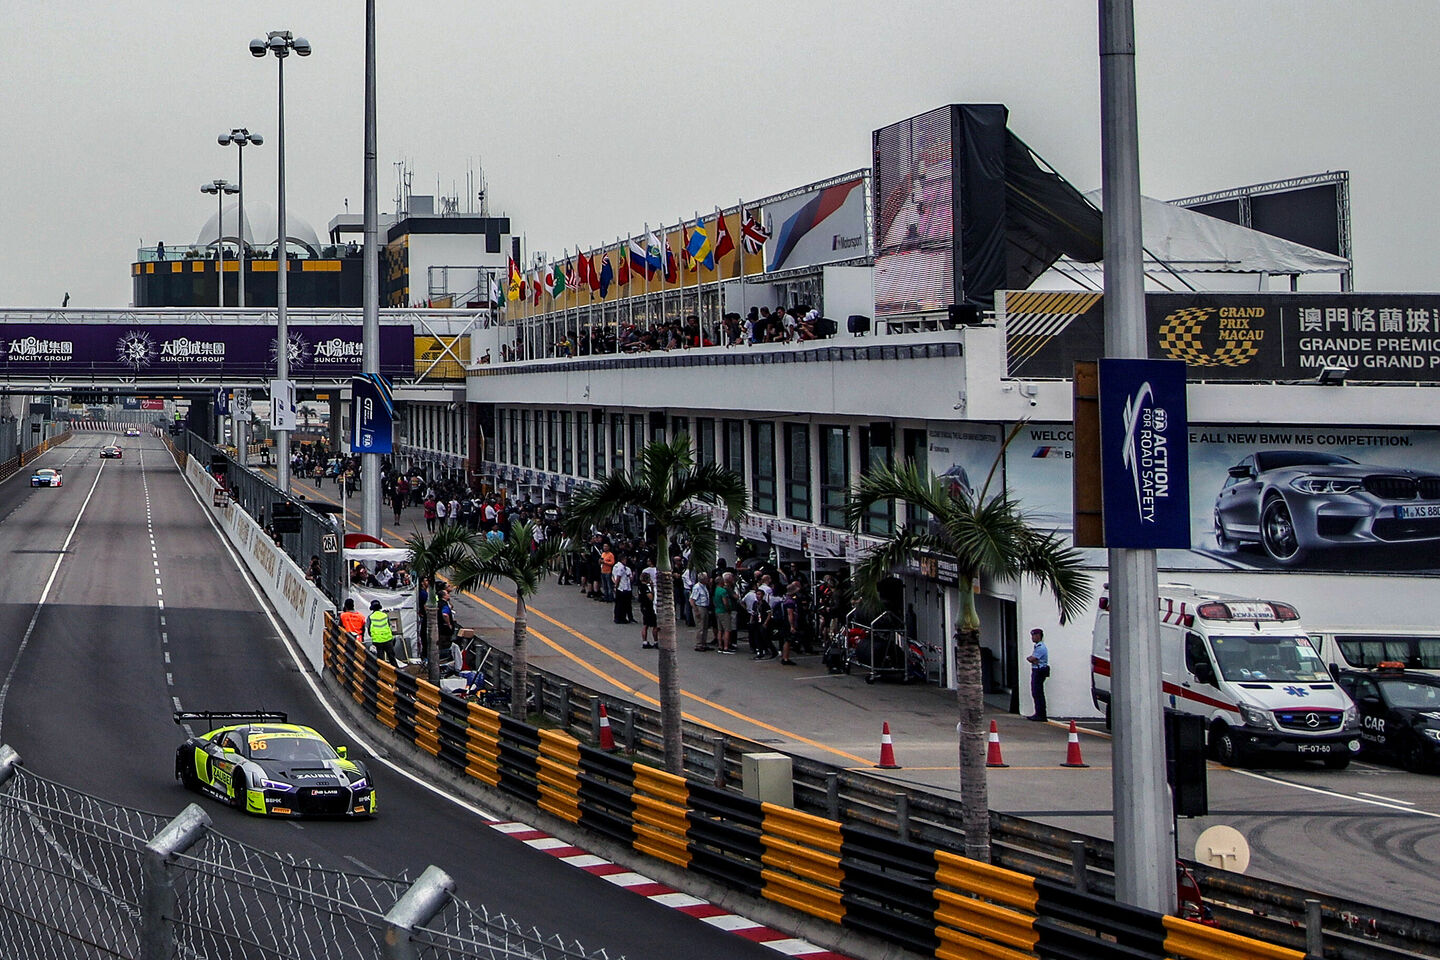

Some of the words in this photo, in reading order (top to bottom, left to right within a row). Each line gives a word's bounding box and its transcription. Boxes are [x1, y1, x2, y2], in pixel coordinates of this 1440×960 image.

[1219, 307, 1265, 318] GRAND
[1219, 318, 1250, 329] PRIX
[1218, 329, 1264, 341] MACAU
[8, 336, 73, 356] 太陽城集團
[160, 337, 225, 356] 太陽城集團
[314, 338, 363, 357] 太陽城集
[1299, 338, 1371, 351] GRANDE
[1300, 355, 1359, 368] MACAU
[1363, 355, 1425, 368] GRAND
[1430, 356, 1440, 368] P
[1143, 408, 1151, 427] FOR
[1153, 408, 1167, 431] FIA
[1031, 431, 1074, 441] WELCO
[1189, 433, 1198, 443] E
[1200, 433, 1225, 444] ALL
[1227, 434, 1257, 444] NEW
[1260, 434, 1292, 445] BMW
[1295, 435, 1314, 445] M5
[1317, 435, 1413, 447] COMPETITION.
[1140, 430, 1153, 467] ROAD
[1154, 434, 1169, 497] ACTION
[1142, 471, 1155, 523] SAFETY
[324, 536, 338, 551] 26A
[1364, 715, 1385, 732] CAR
[250, 740, 268, 751] 66
